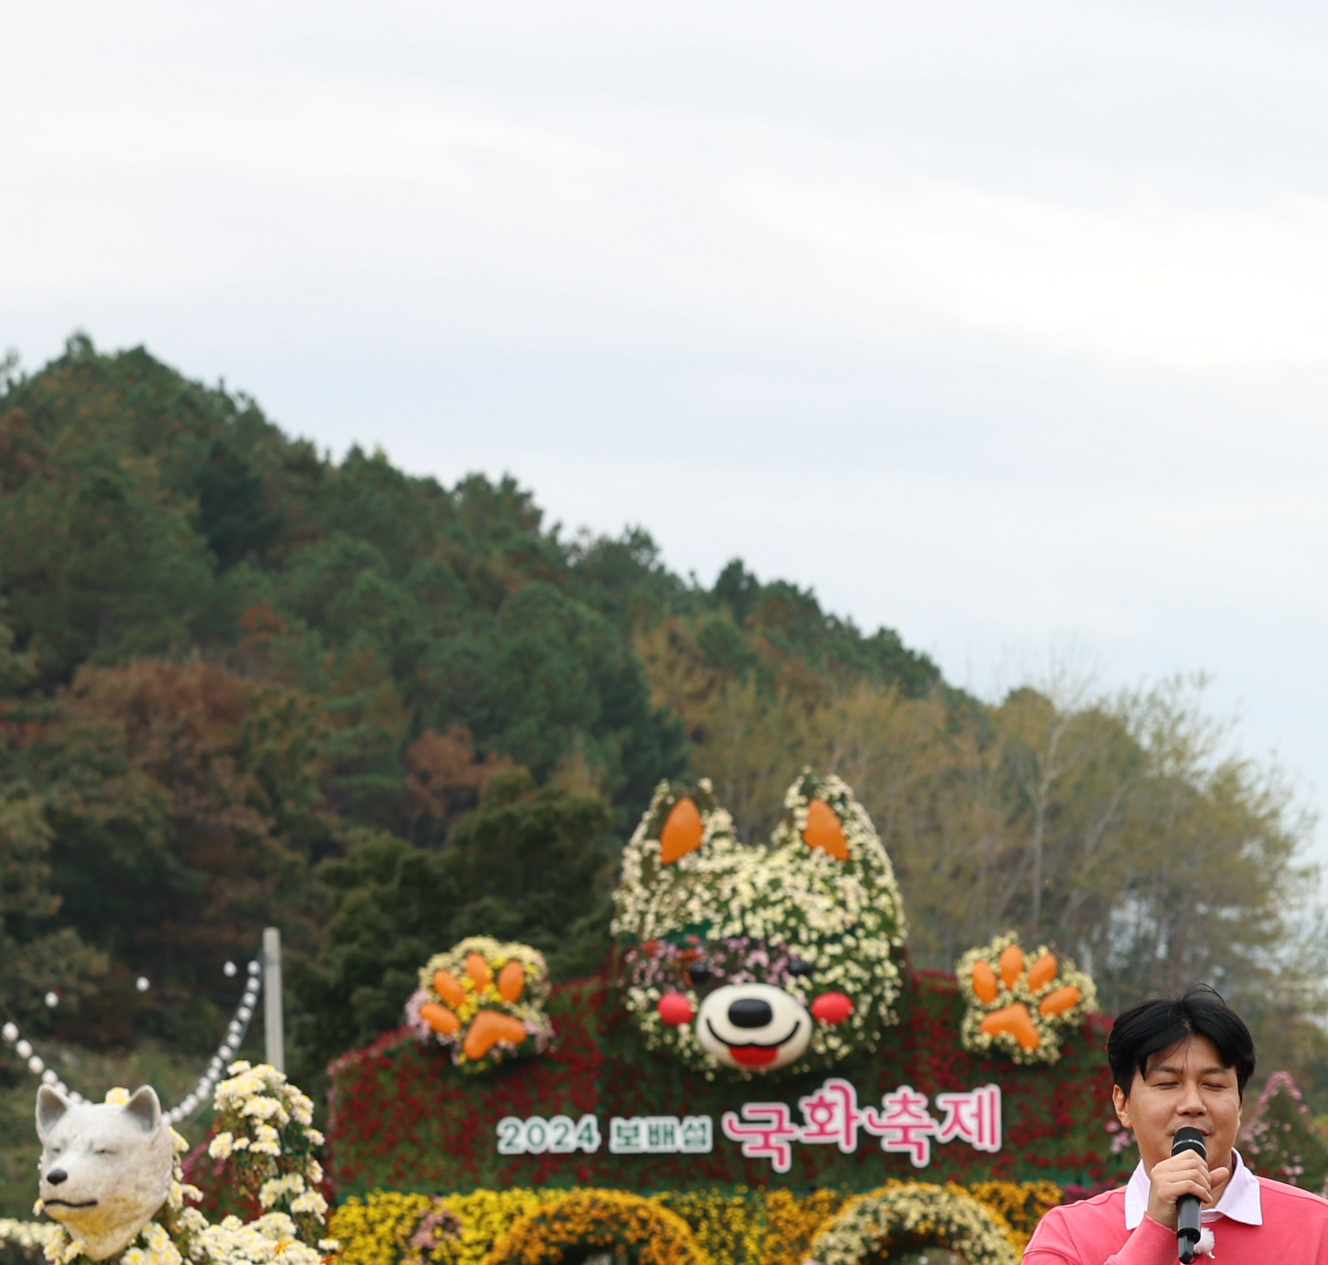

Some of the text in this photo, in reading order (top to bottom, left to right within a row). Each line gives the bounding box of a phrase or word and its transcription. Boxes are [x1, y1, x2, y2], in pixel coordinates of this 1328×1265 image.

[499, 1079, 1000, 1171] 2024 보배섬 국화축제
